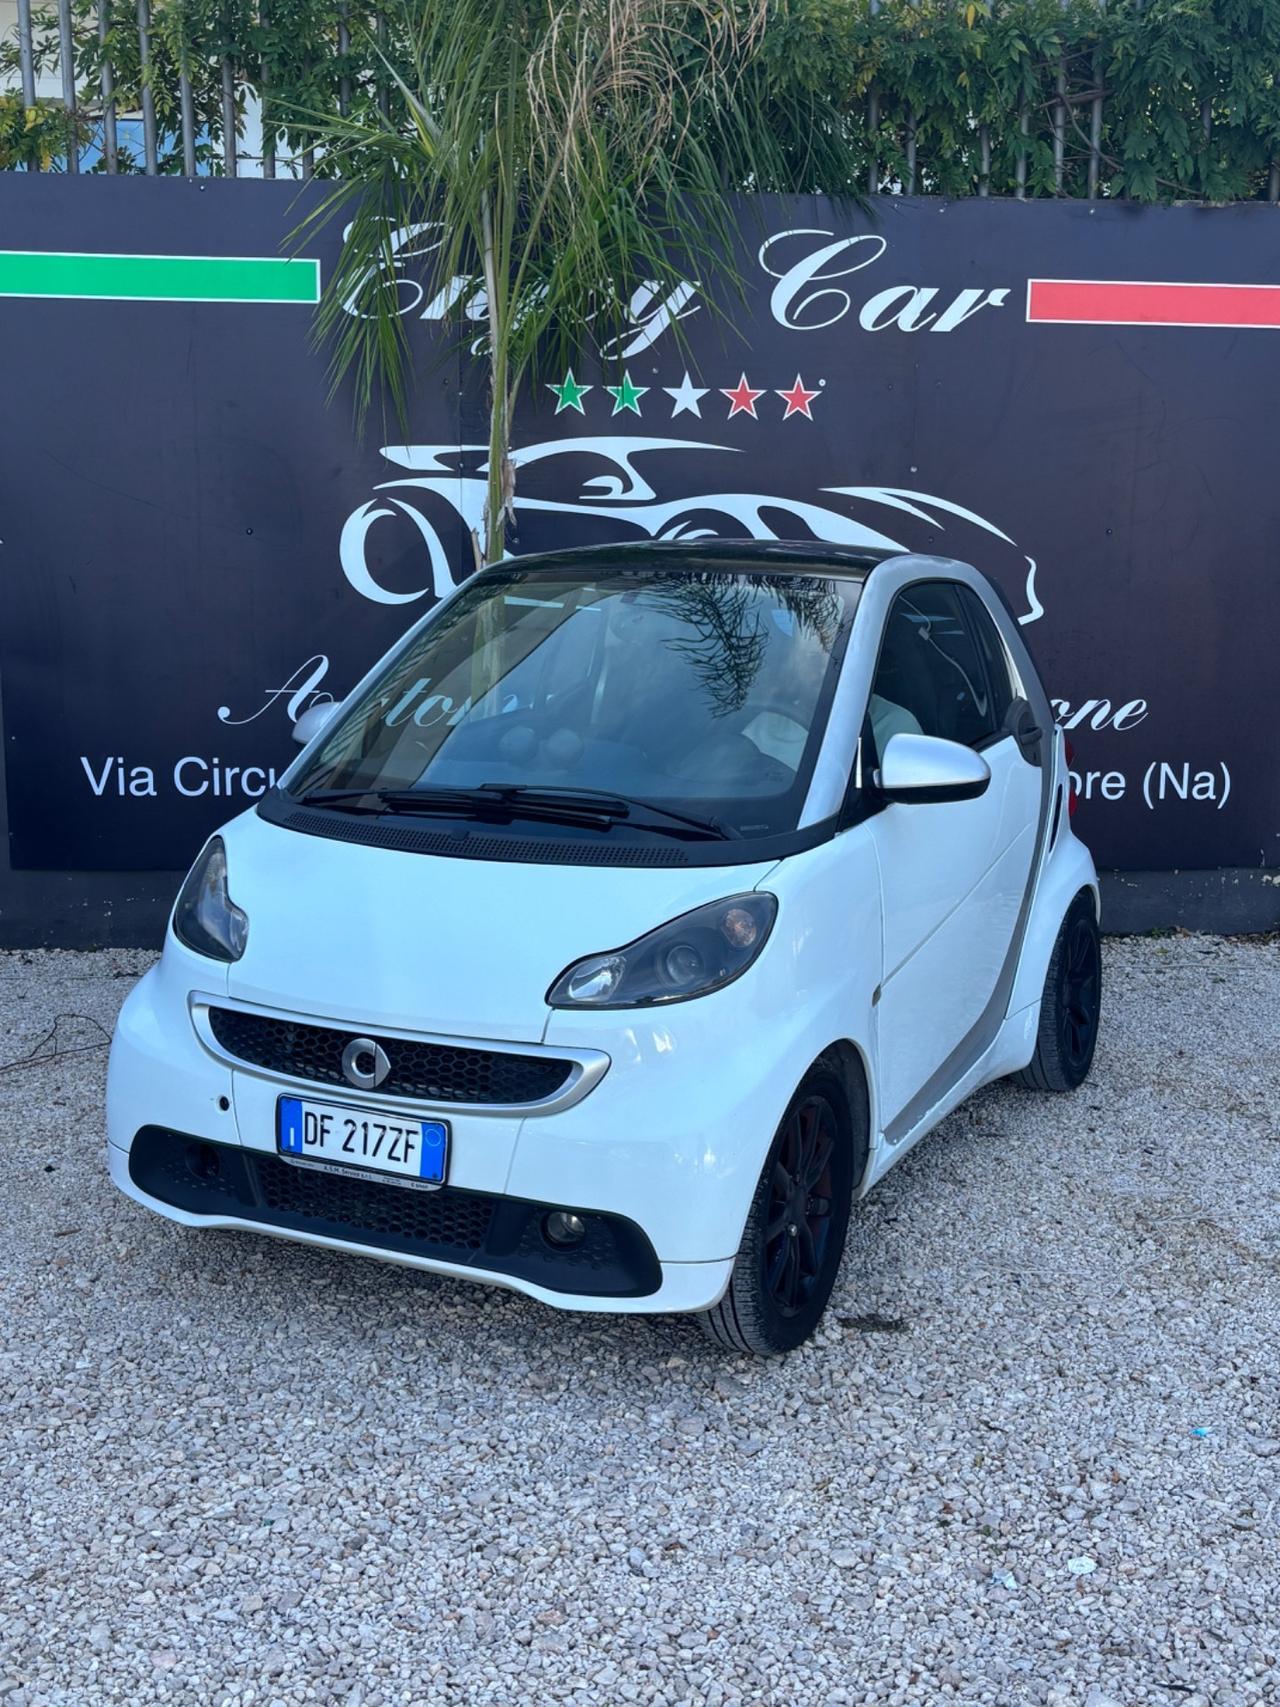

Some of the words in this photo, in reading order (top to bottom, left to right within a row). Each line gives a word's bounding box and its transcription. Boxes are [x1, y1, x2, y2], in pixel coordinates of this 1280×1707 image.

[758, 228, 1012, 333] Car
[80, 756, 157, 797] Via
[1143, 760, 1231, 810] (Na)
[304, 1111, 334, 1147] DF
[342, 1118, 419, 1163] 217ZF
